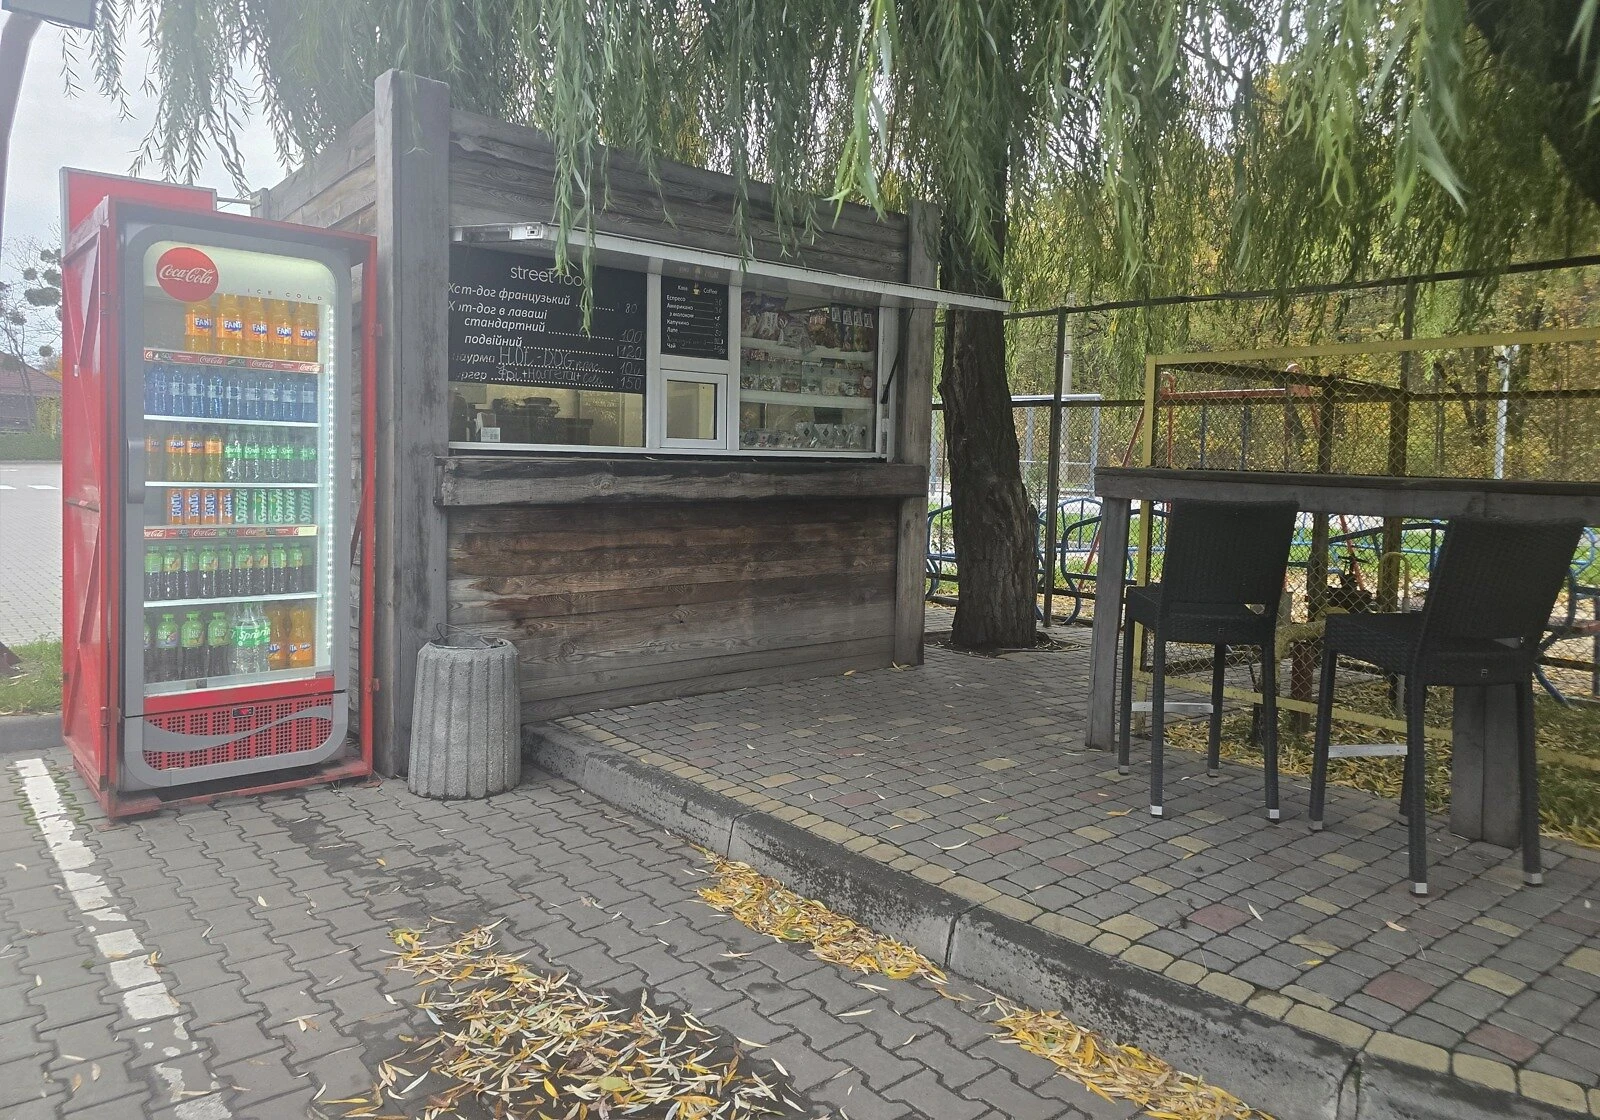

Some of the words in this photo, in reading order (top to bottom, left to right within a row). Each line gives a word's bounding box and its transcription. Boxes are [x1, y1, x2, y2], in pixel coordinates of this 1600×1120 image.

[510, 265, 554, 284] street
[558, 272, 591, 288] foo
[285, 292, 322, 301] COLD
[498, 288, 571, 306] французький
[498, 307, 505, 316] в
[507, 308, 548, 320] лаваші
[625, 303, 638, 314] 80
[464, 317, 546, 333] стандартний
[464, 333, 523, 348] подвійний
[621, 328, 643, 344] 100
[620, 376, 642, 390] 150
